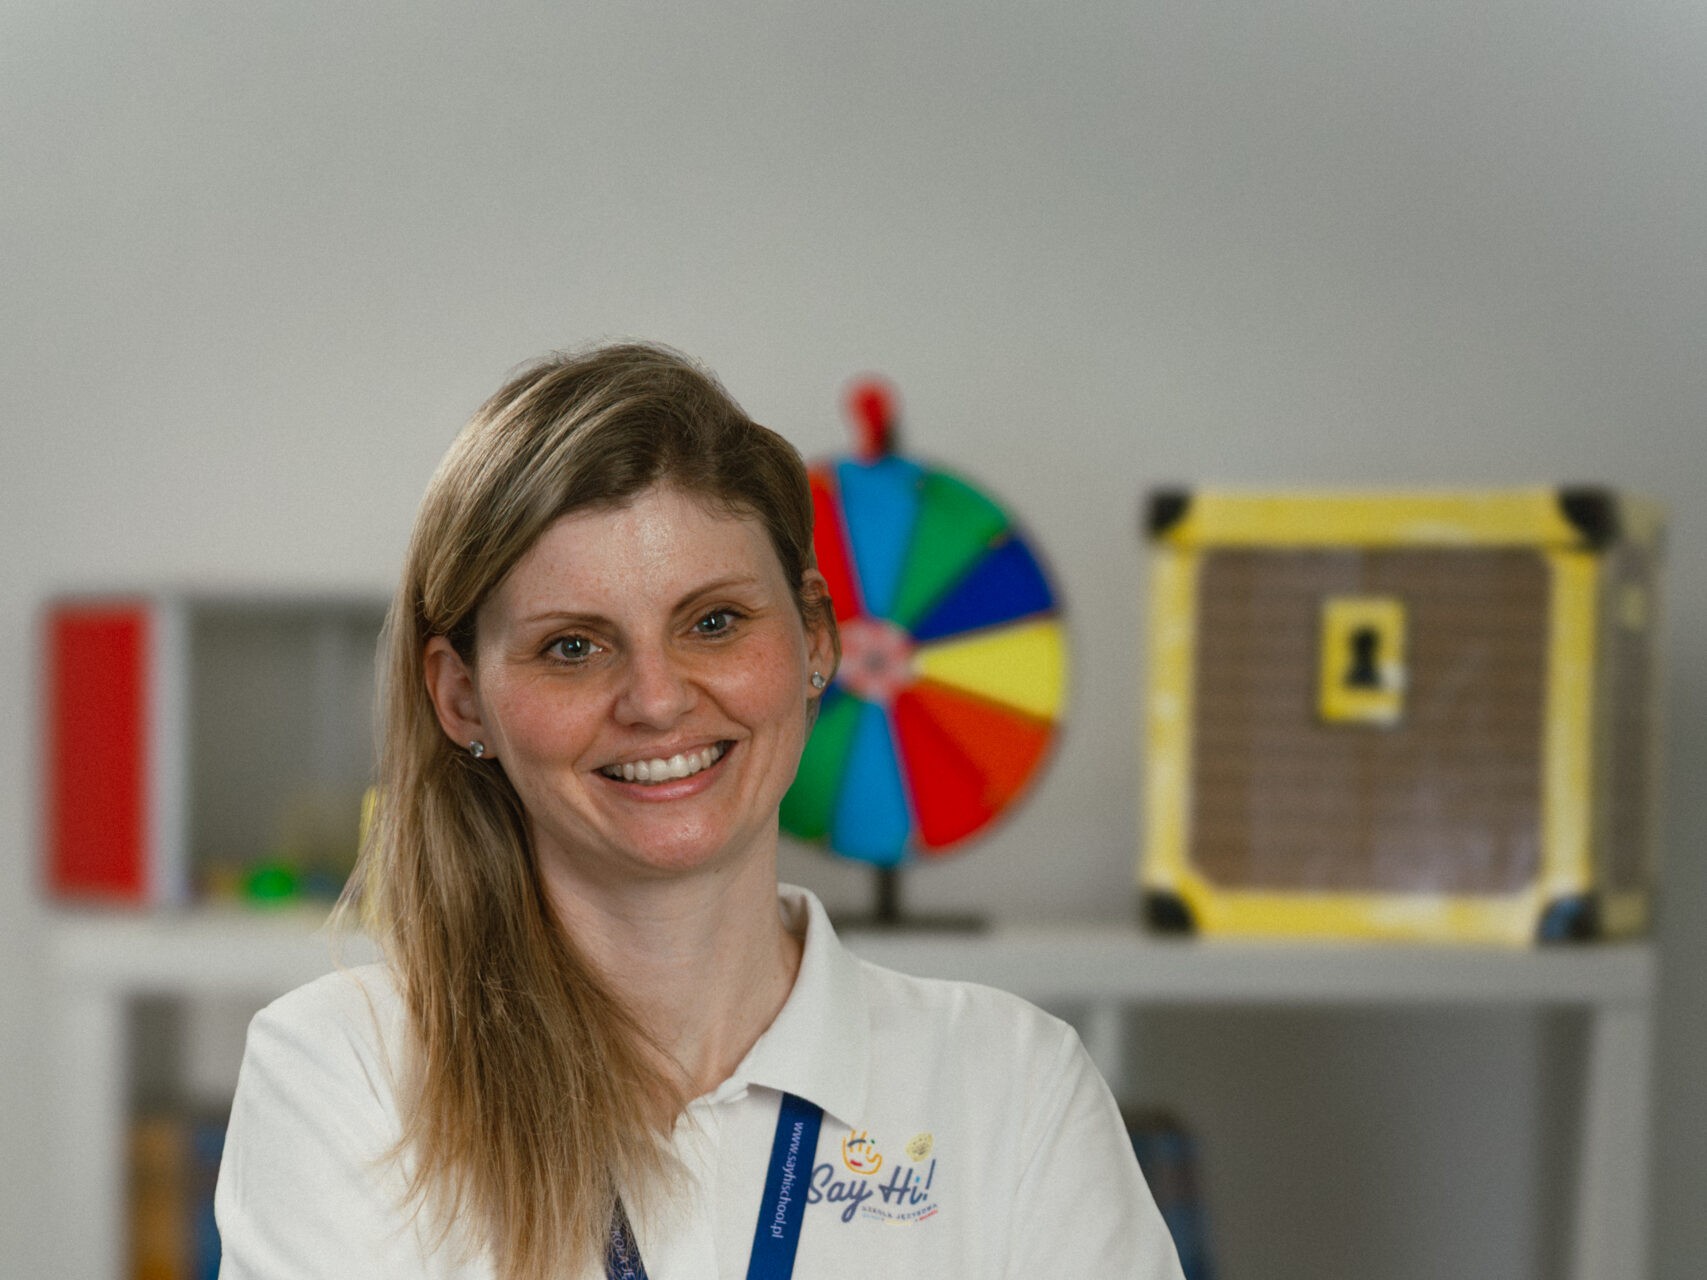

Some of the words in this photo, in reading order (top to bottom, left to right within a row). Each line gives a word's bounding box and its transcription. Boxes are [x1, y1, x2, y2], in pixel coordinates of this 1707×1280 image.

[770, 1121, 804, 1239] www.sayhischool.pl
[806, 1163, 874, 1223] Say
[878, 1158, 936, 1205] Hi!
